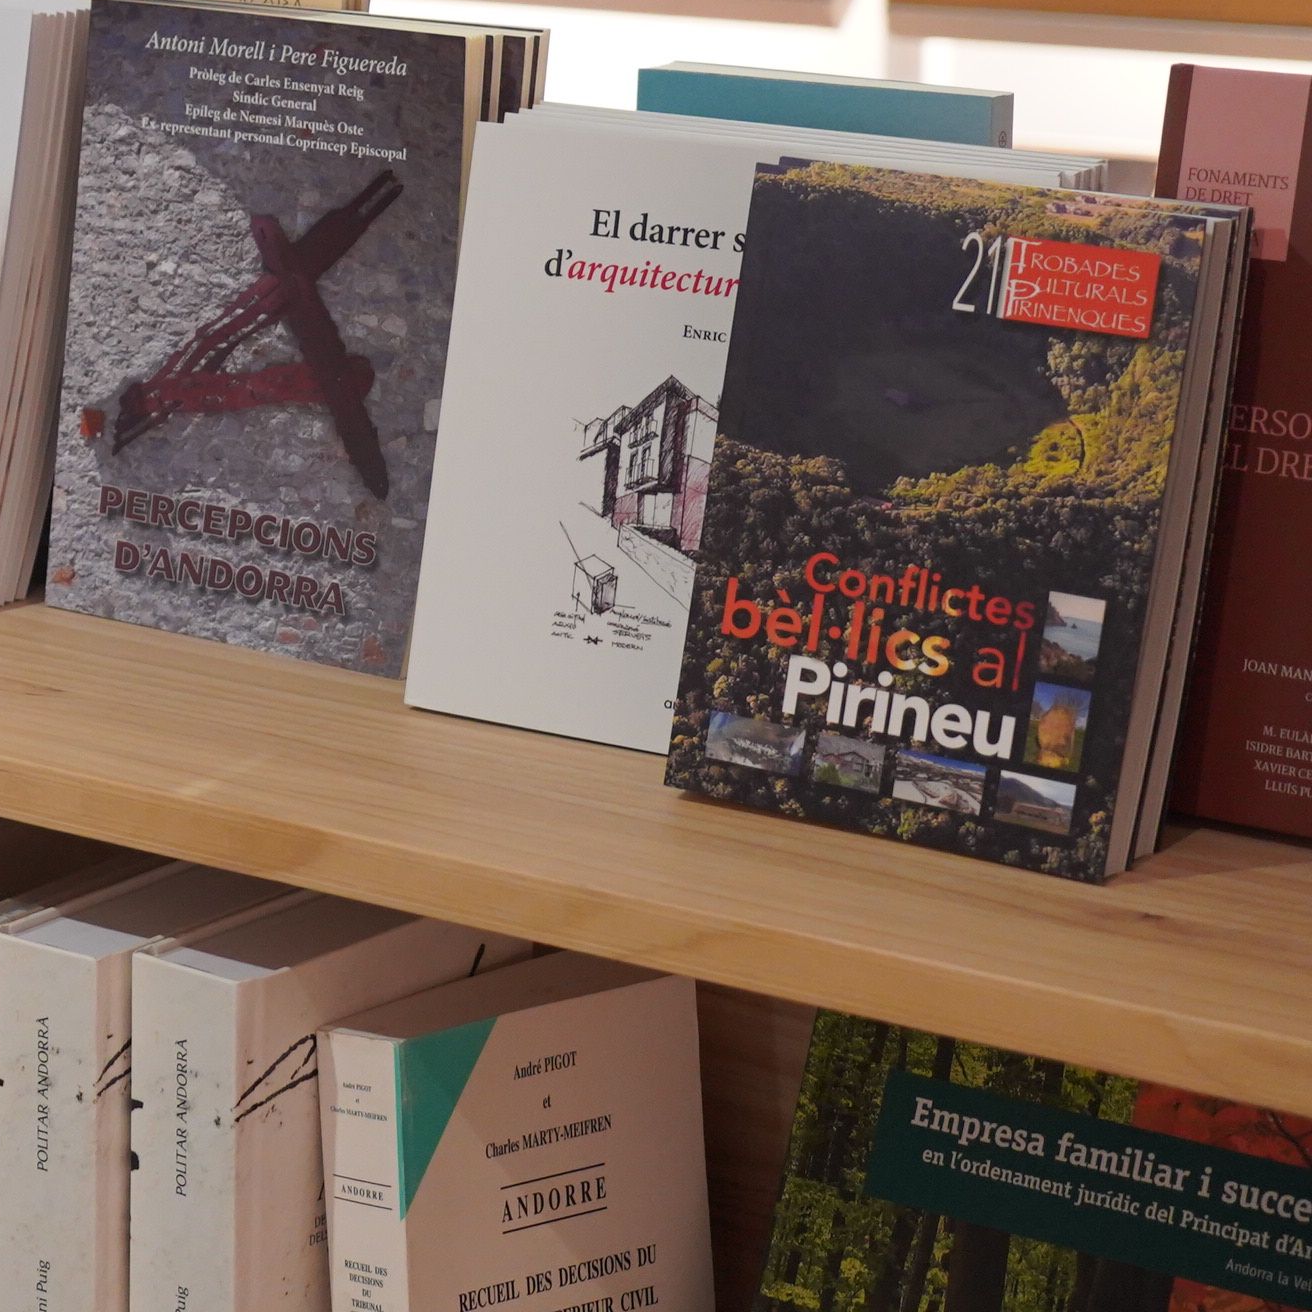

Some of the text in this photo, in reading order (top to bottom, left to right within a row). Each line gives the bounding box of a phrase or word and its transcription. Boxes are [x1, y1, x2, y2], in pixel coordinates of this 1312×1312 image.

[145, 31, 406, 76] Antoni Morell i Pere Figuereda
[189, 66, 364, 101] Pròleg de Carles Ensenyat Reig
[231, 90, 316, 111] Síndic General
[185, 103, 364, 136] Epíleg de Nemesi Marquès Oste
[141, 116, 406, 162] Ex-representant personal Copríncep Episcopal
[1184, 186, 1252, 206] DE DRET
[1188, 168, 1289, 189] FONAMENTS
[590, 209, 620, 239] El
[629, 213, 725, 250] darrer
[1011, 239, 1140, 282] TROBADES
[1006, 280, 1146, 333] PIRINENQUES
[98, 485, 377, 565] PERCEPCIONS
[114, 542, 346, 616] D'ANDORRA
[804, 552, 1036, 630] Conflictes
[971, 630, 1028, 692] al
[1243, 659, 1277, 675] JOAN
[781, 655, 1017, 759] Pirineu
[1244, 739, 1282, 756] ISIDRE
[1253, 760, 1296, 776] XAVIER
[515, 1051, 576, 1079] André PIGOT
[36, 1017, 51, 1172] POLITAR ANDORRÀ
[543, 1095, 552, 1110] et
[175, 1039, 190, 1196] POLITAR ANDORRÀ
[485, 1115, 611, 1159] Charles MARTY-MEIFREN
[911, 1097, 1044, 1156] Empresa
[1055, 1132, 1190, 1190] familiar
[1197, 1166, 1212, 1198] i
[341, 1184, 384, 1201] ANDORRE
[501, 1176, 608, 1224] ANDORRE
[922, 1149, 1270, 1248] en l'ordenament jurídic del Principat
[36, 1259, 50, 1293] Puig
[344, 1259, 387, 1276] RECUEIL DES
[349, 1273, 384, 1288] DECISIONS
[458, 1280, 519, 1312] RECUEIL
[526, 1270, 552, 1295] DES
[559, 1251, 631, 1286] DECISIONS
[637, 1244, 656, 1267] DU
[1225, 1258, 1289, 1285] Andorra la
[362, 1288, 371, 1297] DU
[620, 1285, 659, 1312] CIVIL
